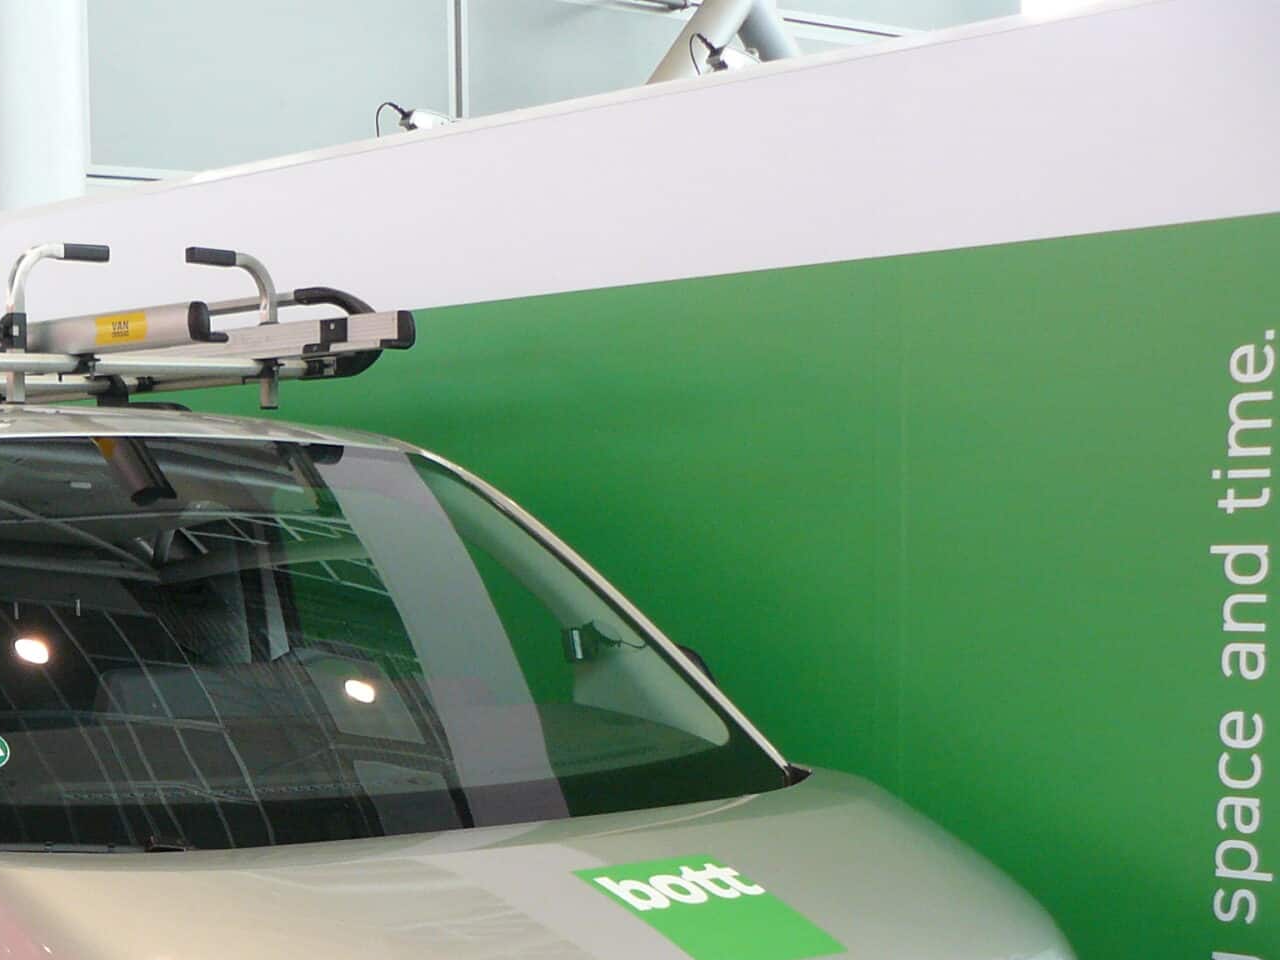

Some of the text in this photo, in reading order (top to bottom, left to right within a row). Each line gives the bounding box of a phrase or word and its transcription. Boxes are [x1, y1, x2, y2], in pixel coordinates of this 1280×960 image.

[1212, 328, 1276, 514] time.
[1210, 544, 1269, 681] and
[593, 863, 766, 911] bott
[1213, 711, 1273, 924] space
